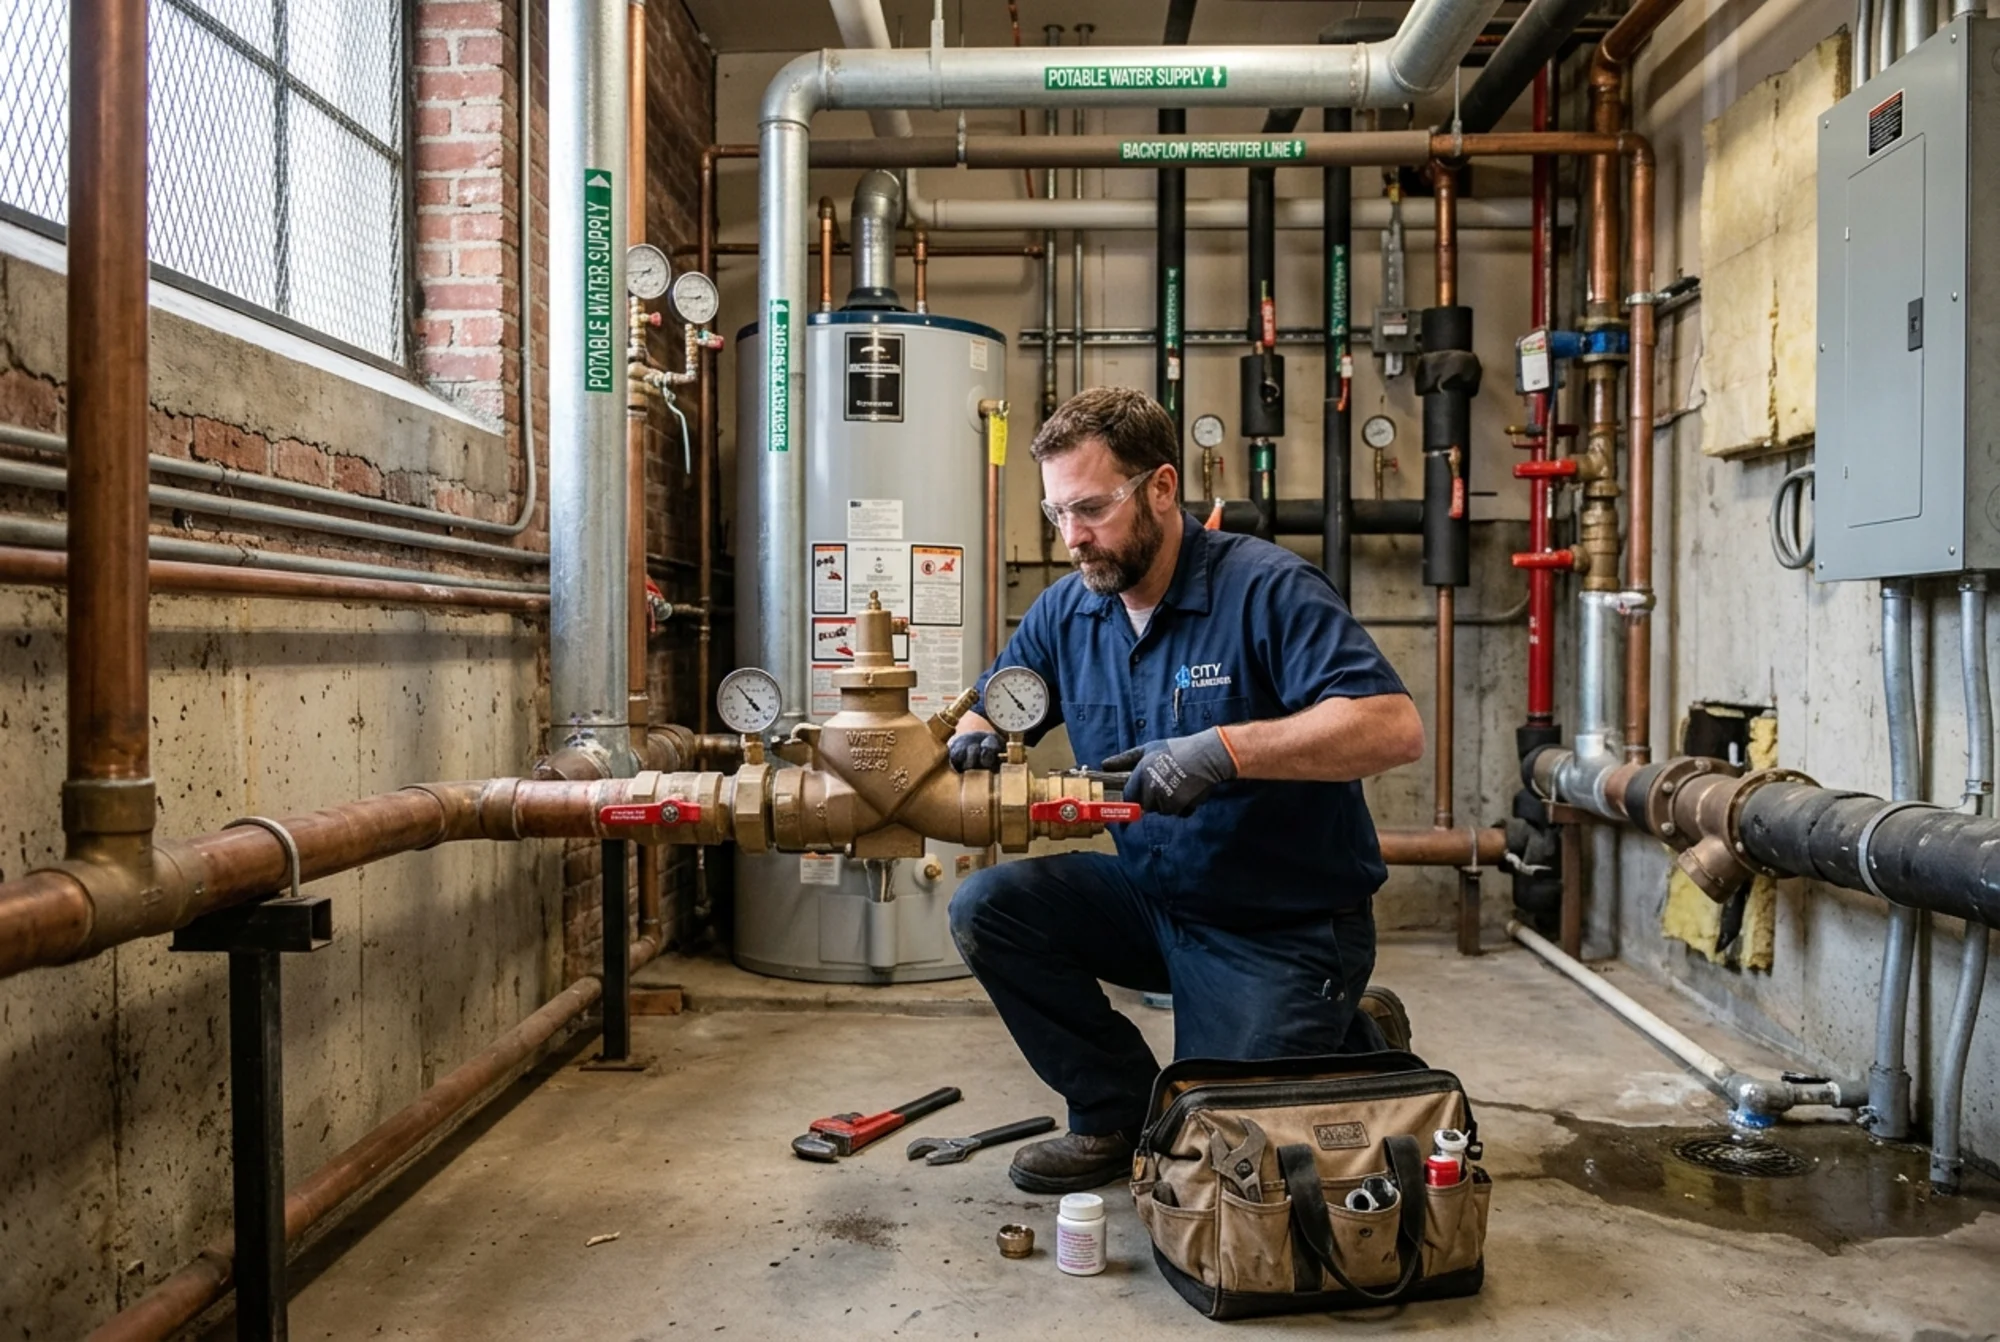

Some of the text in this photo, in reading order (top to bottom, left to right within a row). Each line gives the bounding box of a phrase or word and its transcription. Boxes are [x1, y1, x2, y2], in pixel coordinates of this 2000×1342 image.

[1048, 67, 1207, 87] POTABLE WATER SUPPLY
[587, 201, 610, 263] SUPPLY
[588, 320, 610, 388] POTABLE
[1191, 662, 1222, 679] CITY
